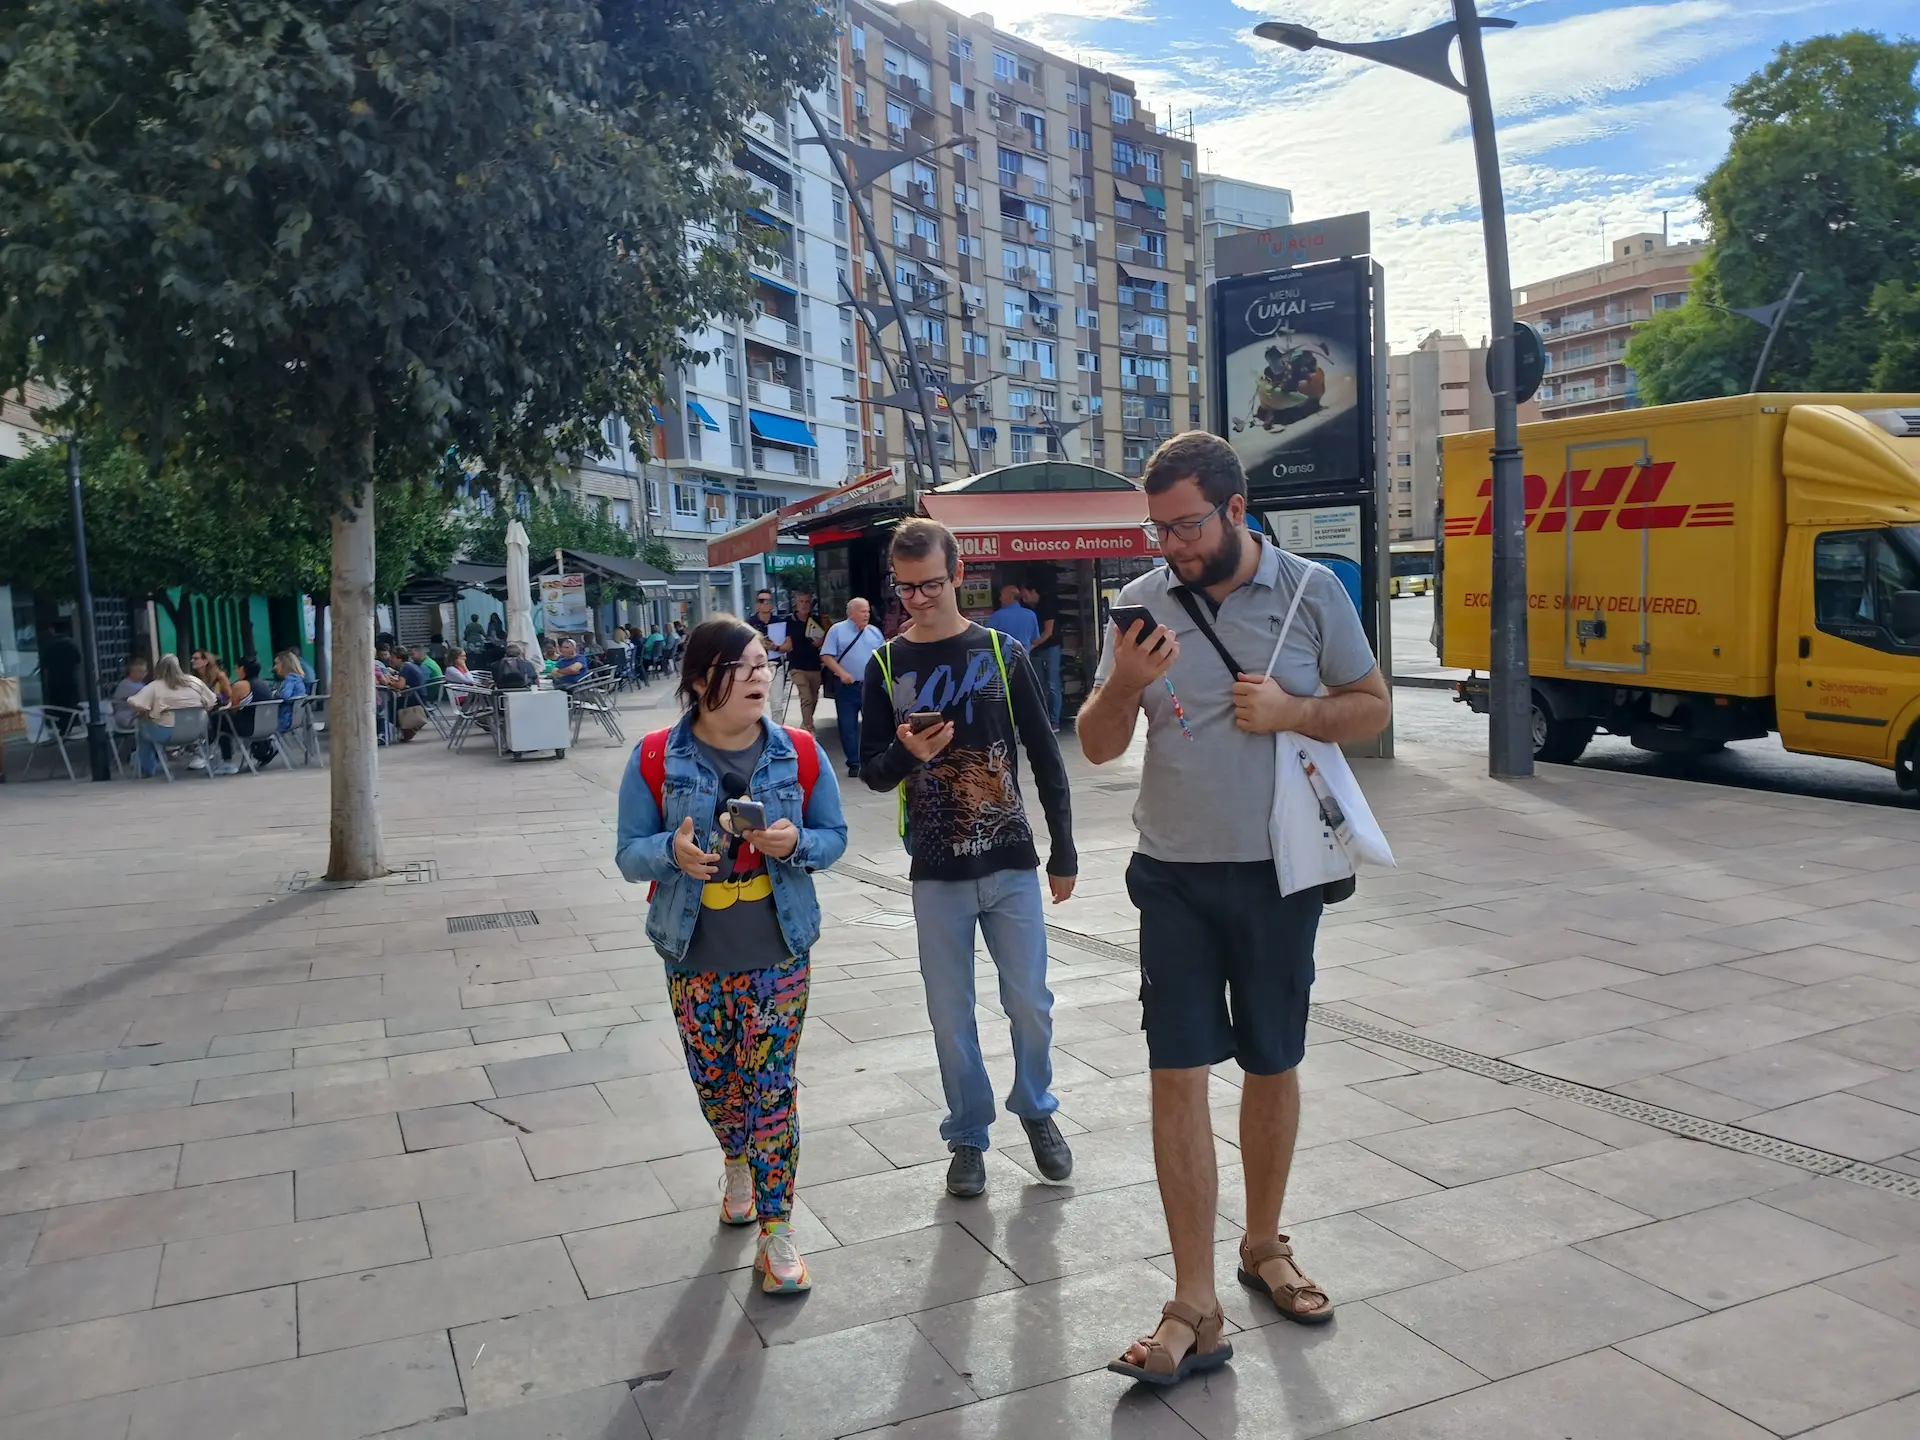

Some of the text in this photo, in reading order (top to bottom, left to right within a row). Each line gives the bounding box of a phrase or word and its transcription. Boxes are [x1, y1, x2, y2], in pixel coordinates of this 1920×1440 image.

[1257, 299, 1306, 319] UMAI
[1288, 463, 1315, 474] enso
[1474, 461, 1691, 535] DHL
[1010, 537, 1071, 552] Quiosco
[1075, 535, 1133, 550] Antonio
[1463, 592, 1701, 616] EXCCE. SIMPLY DELIVERED.
[1819, 680, 1889, 696] Servicepartner
